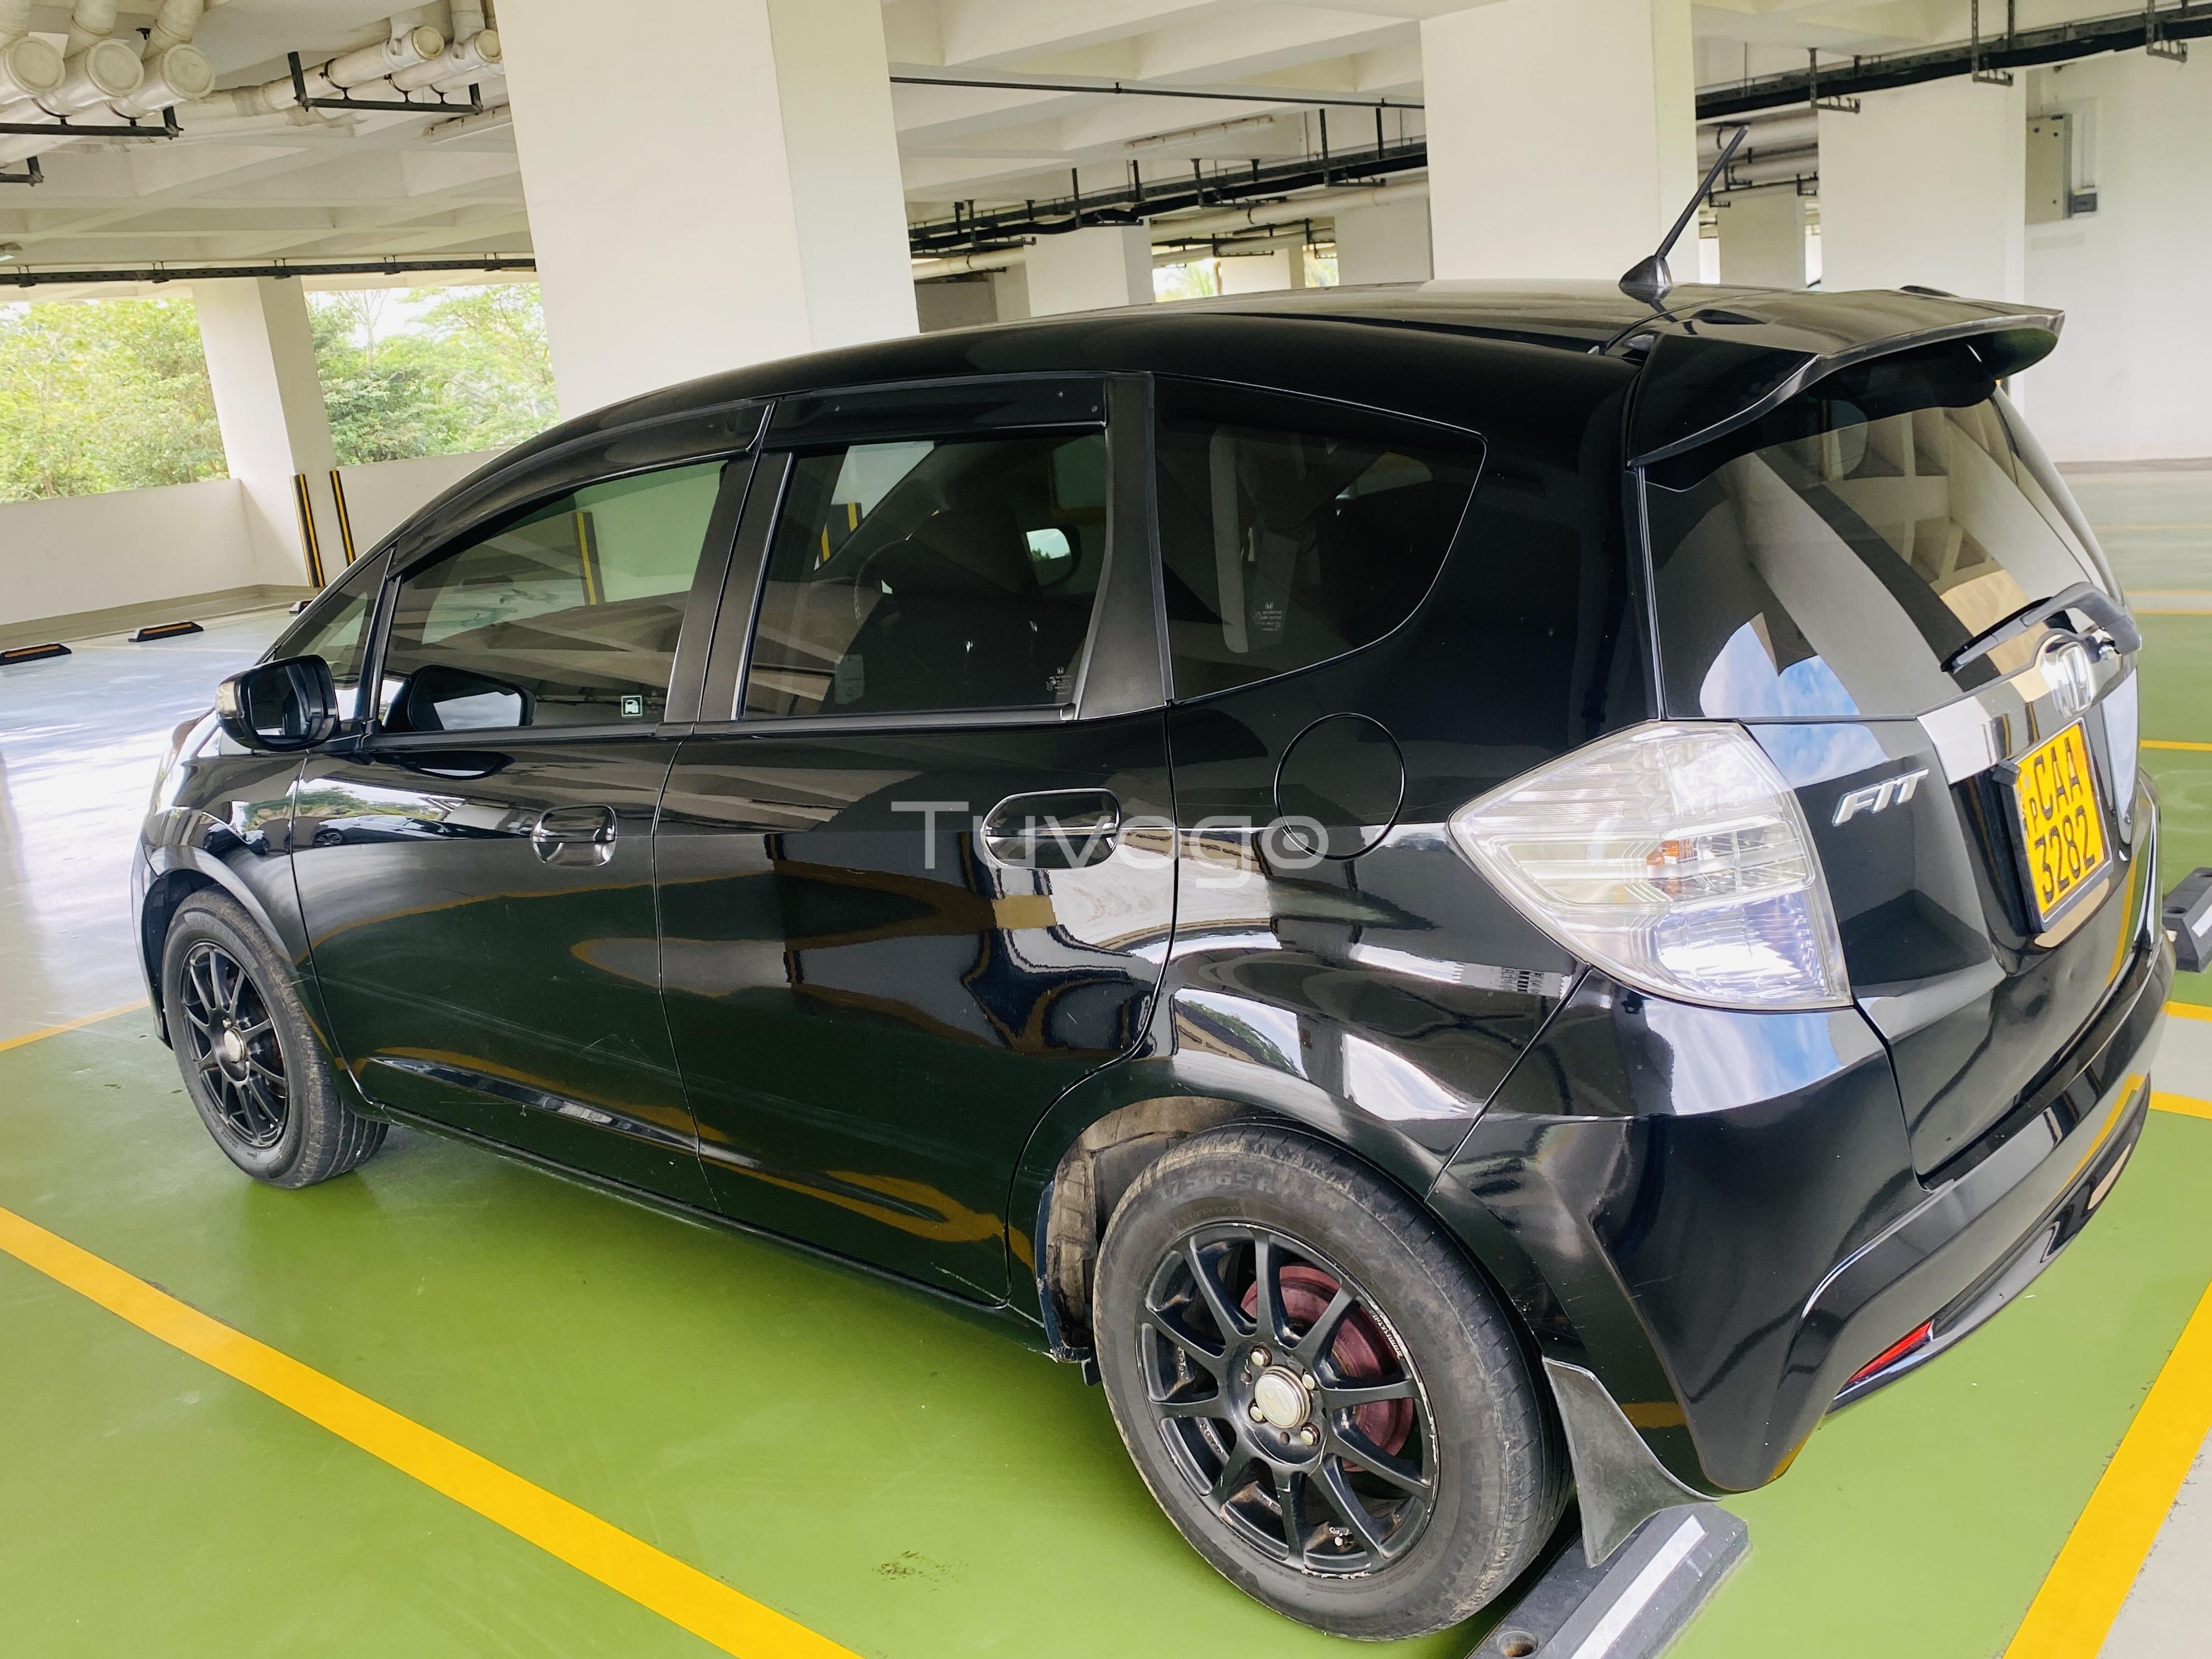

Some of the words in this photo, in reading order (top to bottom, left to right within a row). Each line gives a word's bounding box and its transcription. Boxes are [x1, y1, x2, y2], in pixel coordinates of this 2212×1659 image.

[1831, 768, 1929, 826] FIT
[2033, 737, 2083, 820] CAA
[2034, 805, 2095, 904] 3282
